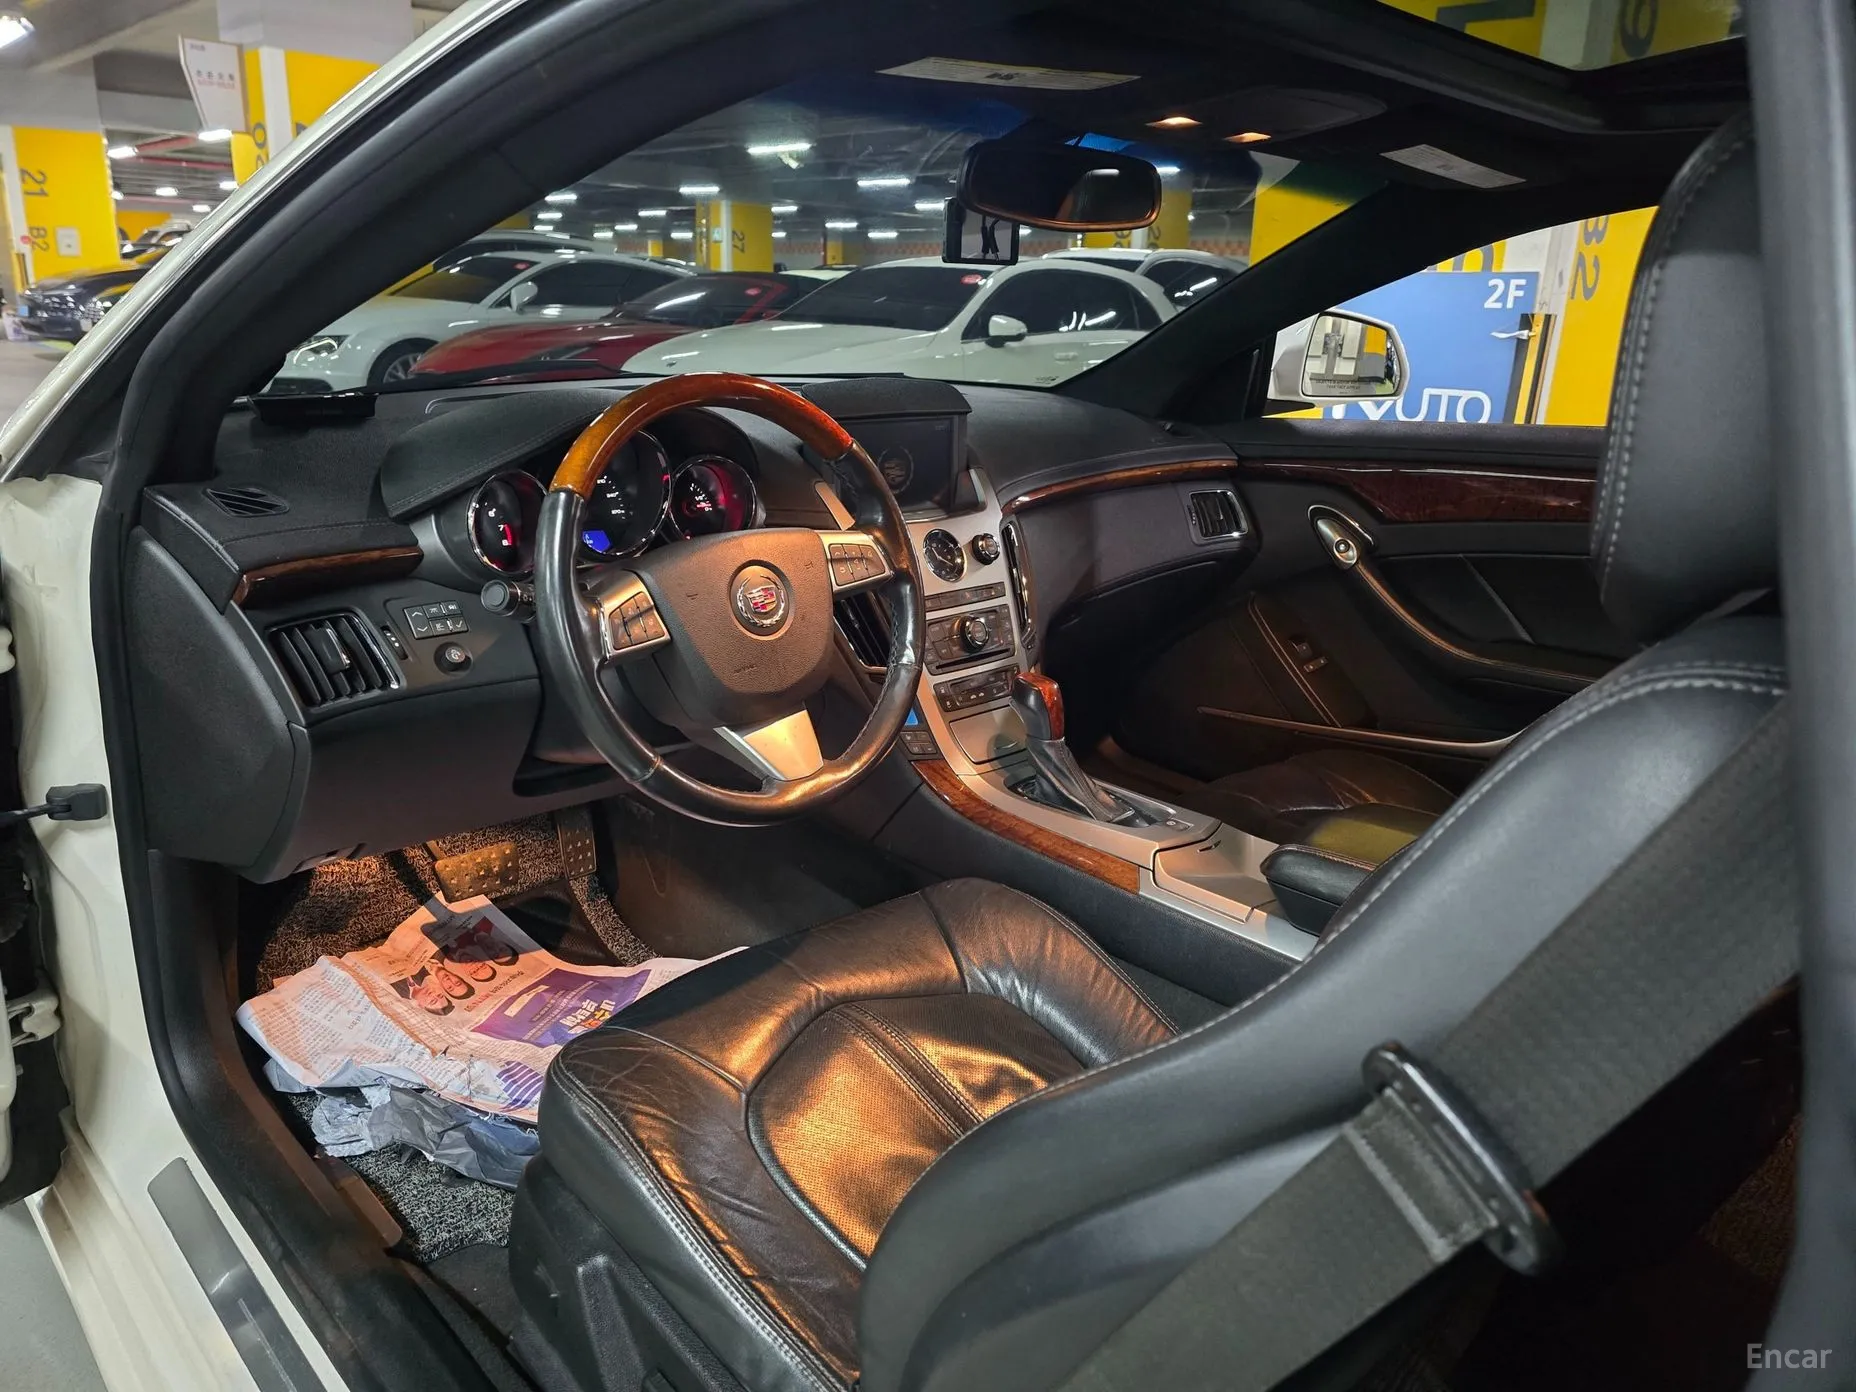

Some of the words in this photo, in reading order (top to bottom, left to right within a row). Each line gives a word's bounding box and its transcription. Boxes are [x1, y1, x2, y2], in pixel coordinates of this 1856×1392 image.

[20, 167, 49, 197] 21
[731, 229, 745, 253] 27
[1484, 279, 1527, 309] 2F
